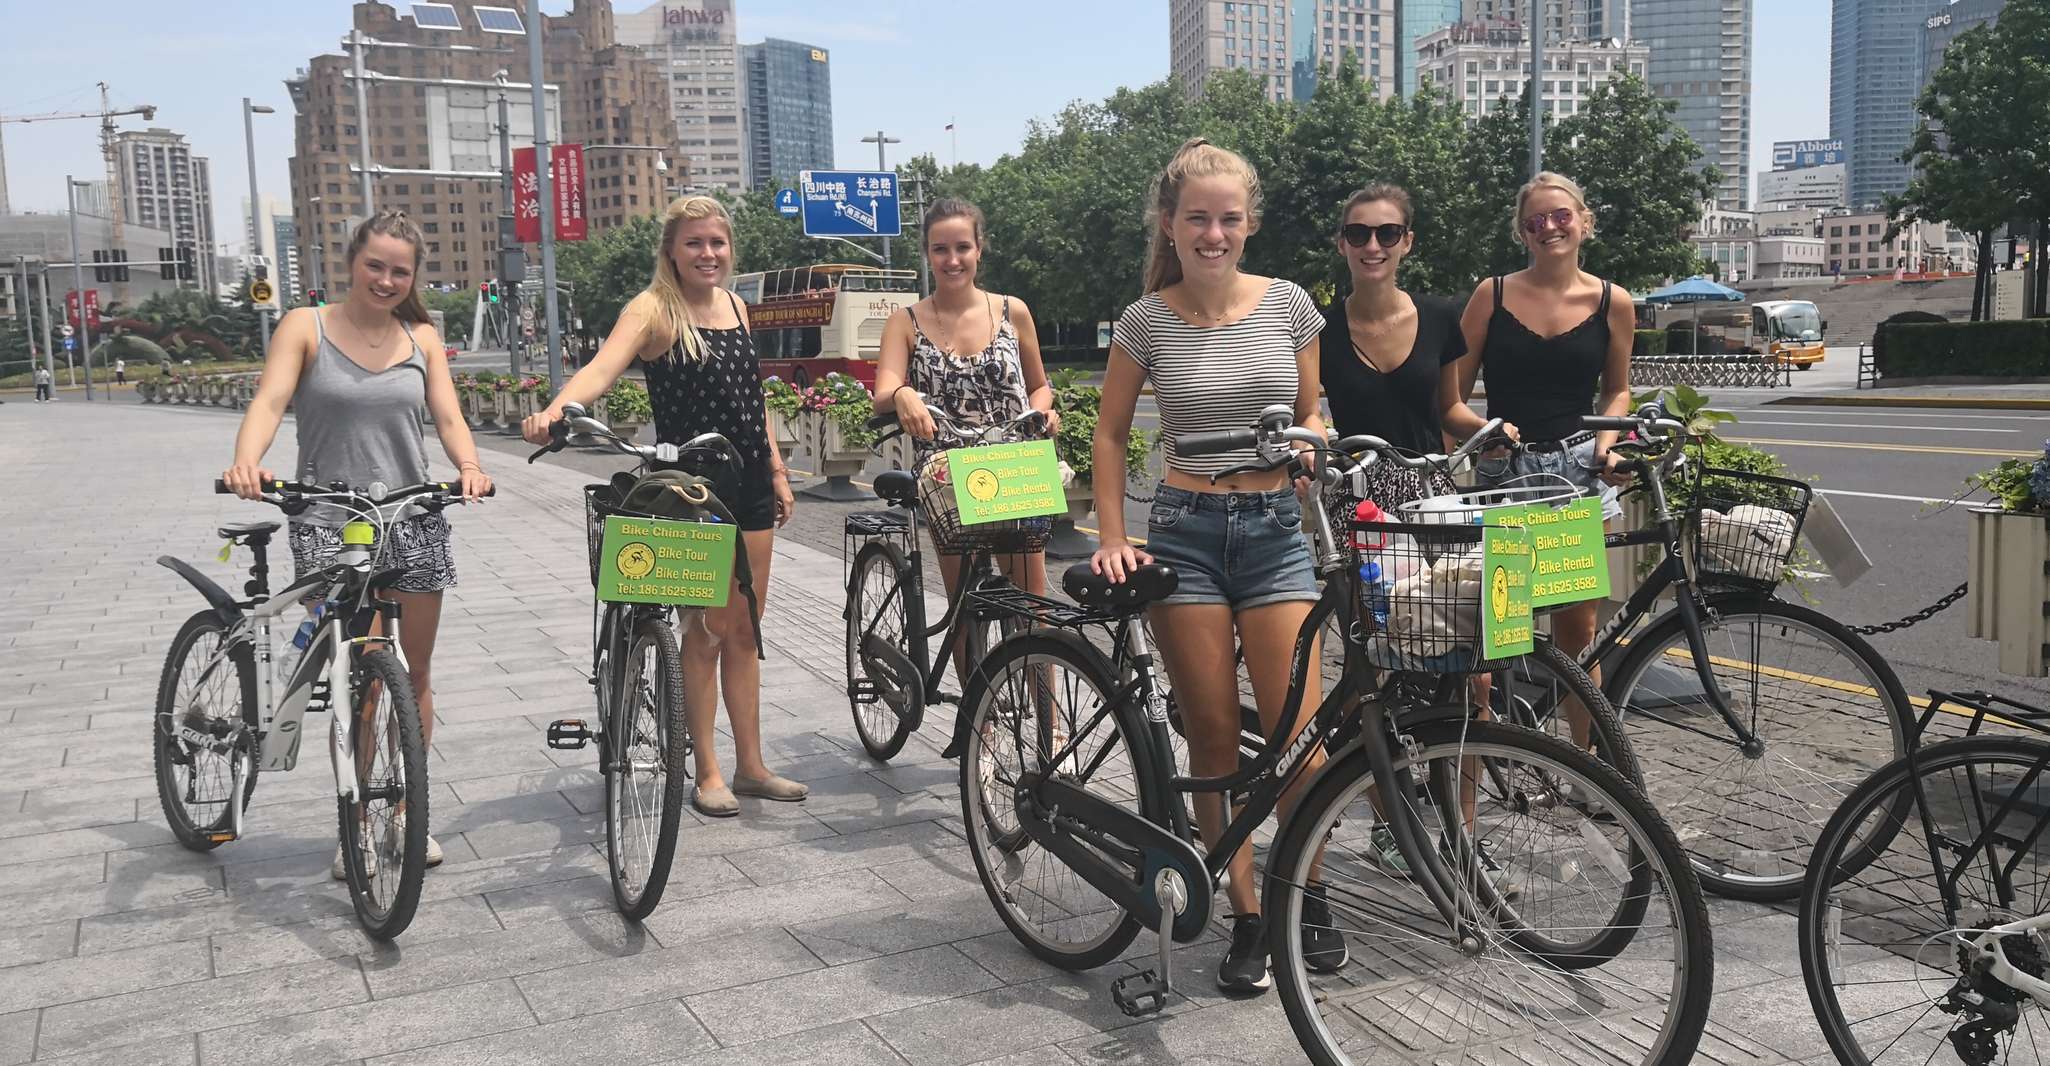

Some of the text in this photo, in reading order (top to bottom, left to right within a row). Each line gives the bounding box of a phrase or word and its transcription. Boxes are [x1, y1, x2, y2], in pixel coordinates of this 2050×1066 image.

[663, 6, 724, 28] Jahwa
[1927, 15, 1952, 29] SIPG
[1797, 140, 1842, 153] Abbott
[805, 181, 846, 193] 四川中路
[857, 176, 891, 189] 长治路
[962, 447, 1045, 464] Bike China Tours
[998, 466, 1039, 479] Bike Tour
[1001, 483, 1051, 497] Bike Rental
[1499, 508, 1591, 527] Bike China Tours
[622, 524, 723, 541] Bike China Tours
[1491, 539, 1505, 554] Bike
[1536, 533, 1582, 550] Bike Tour
[658, 547, 708, 561] Bike Tour
[1539, 554, 1594, 575] Bike Rental
[655, 567, 716, 581] Bike Rental
[617, 583, 715, 599] Tel: 186 1625 3582
[1532, 576, 1598, 597] 86 1625 3582
[1577, 600, 1630, 665] GIANT
[182, 728, 219, 751] GIANT
[1275, 716, 1318, 778] GIANT
